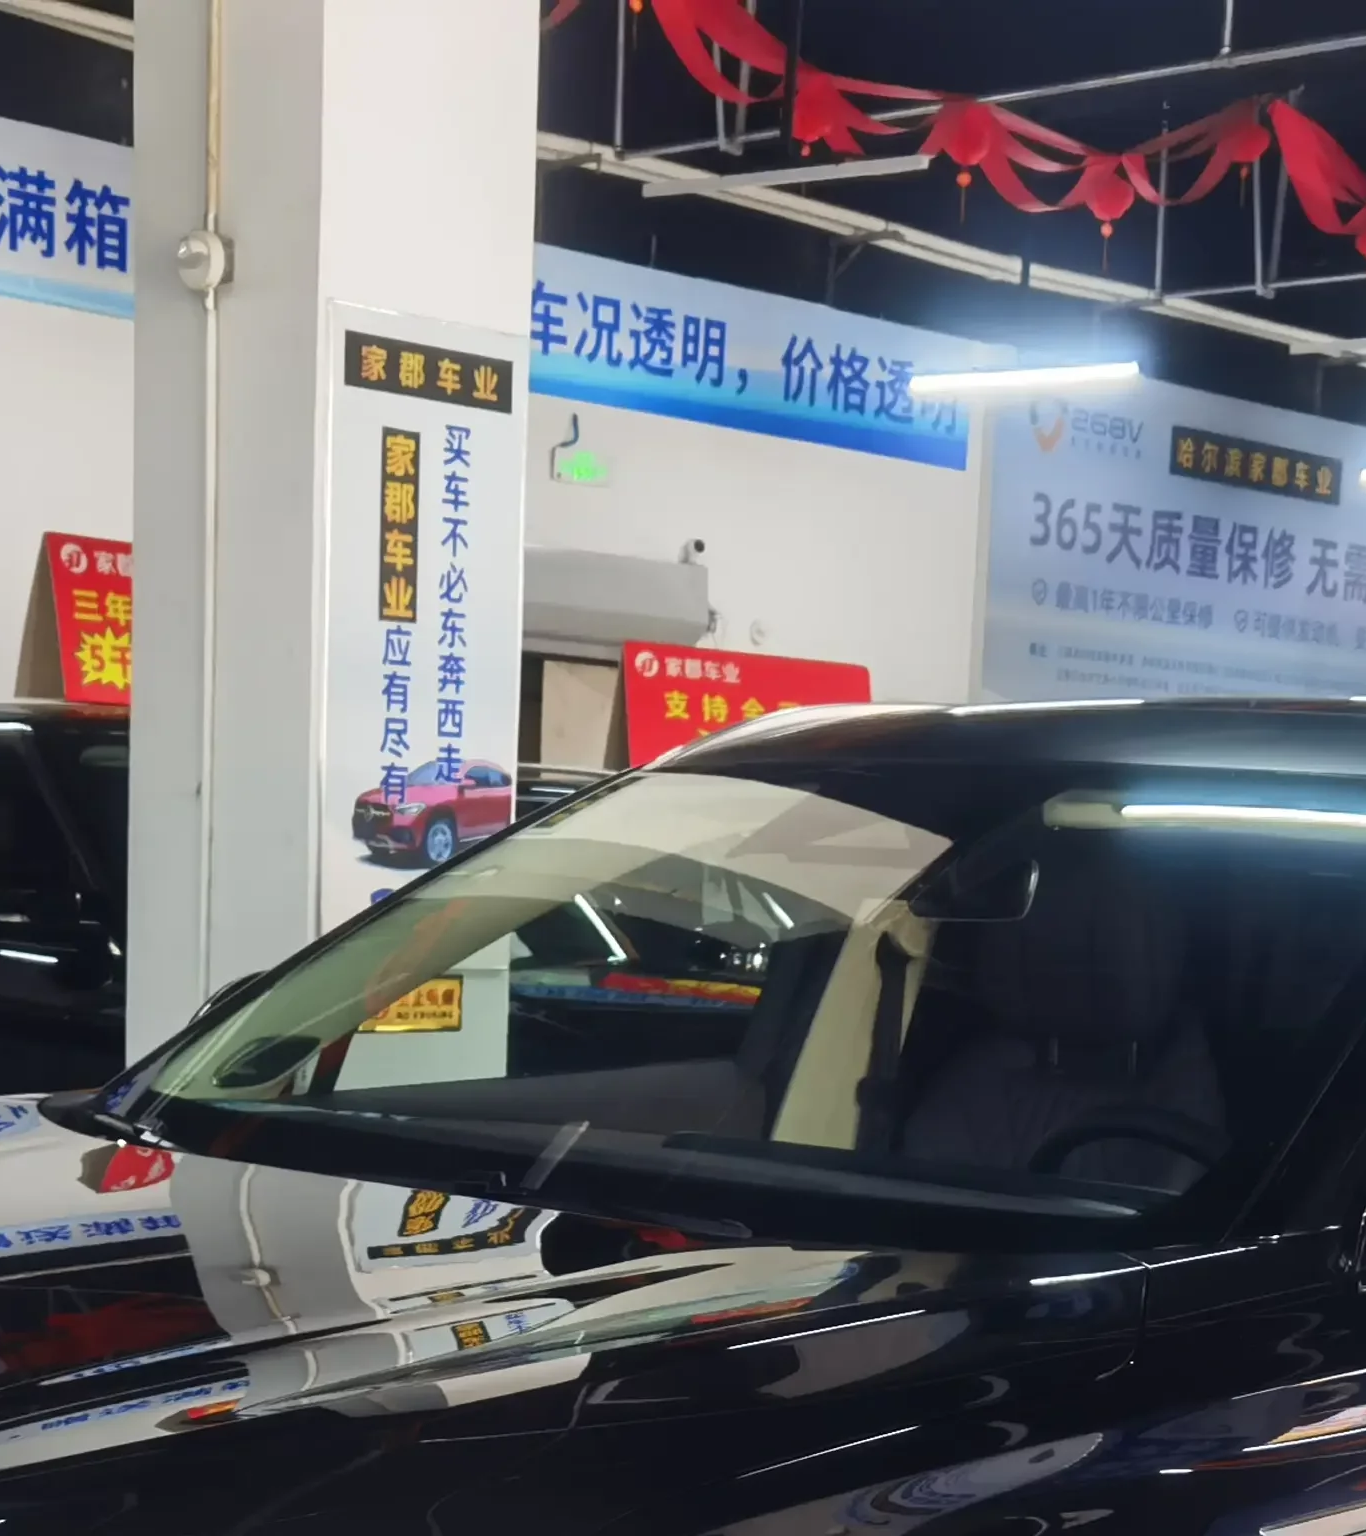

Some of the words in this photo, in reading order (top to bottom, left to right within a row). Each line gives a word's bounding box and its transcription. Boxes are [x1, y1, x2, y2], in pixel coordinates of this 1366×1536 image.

[437, 424, 471, 785] 买车不必东奔西走
[1029, 492, 1297, 590] 365天质量保修
